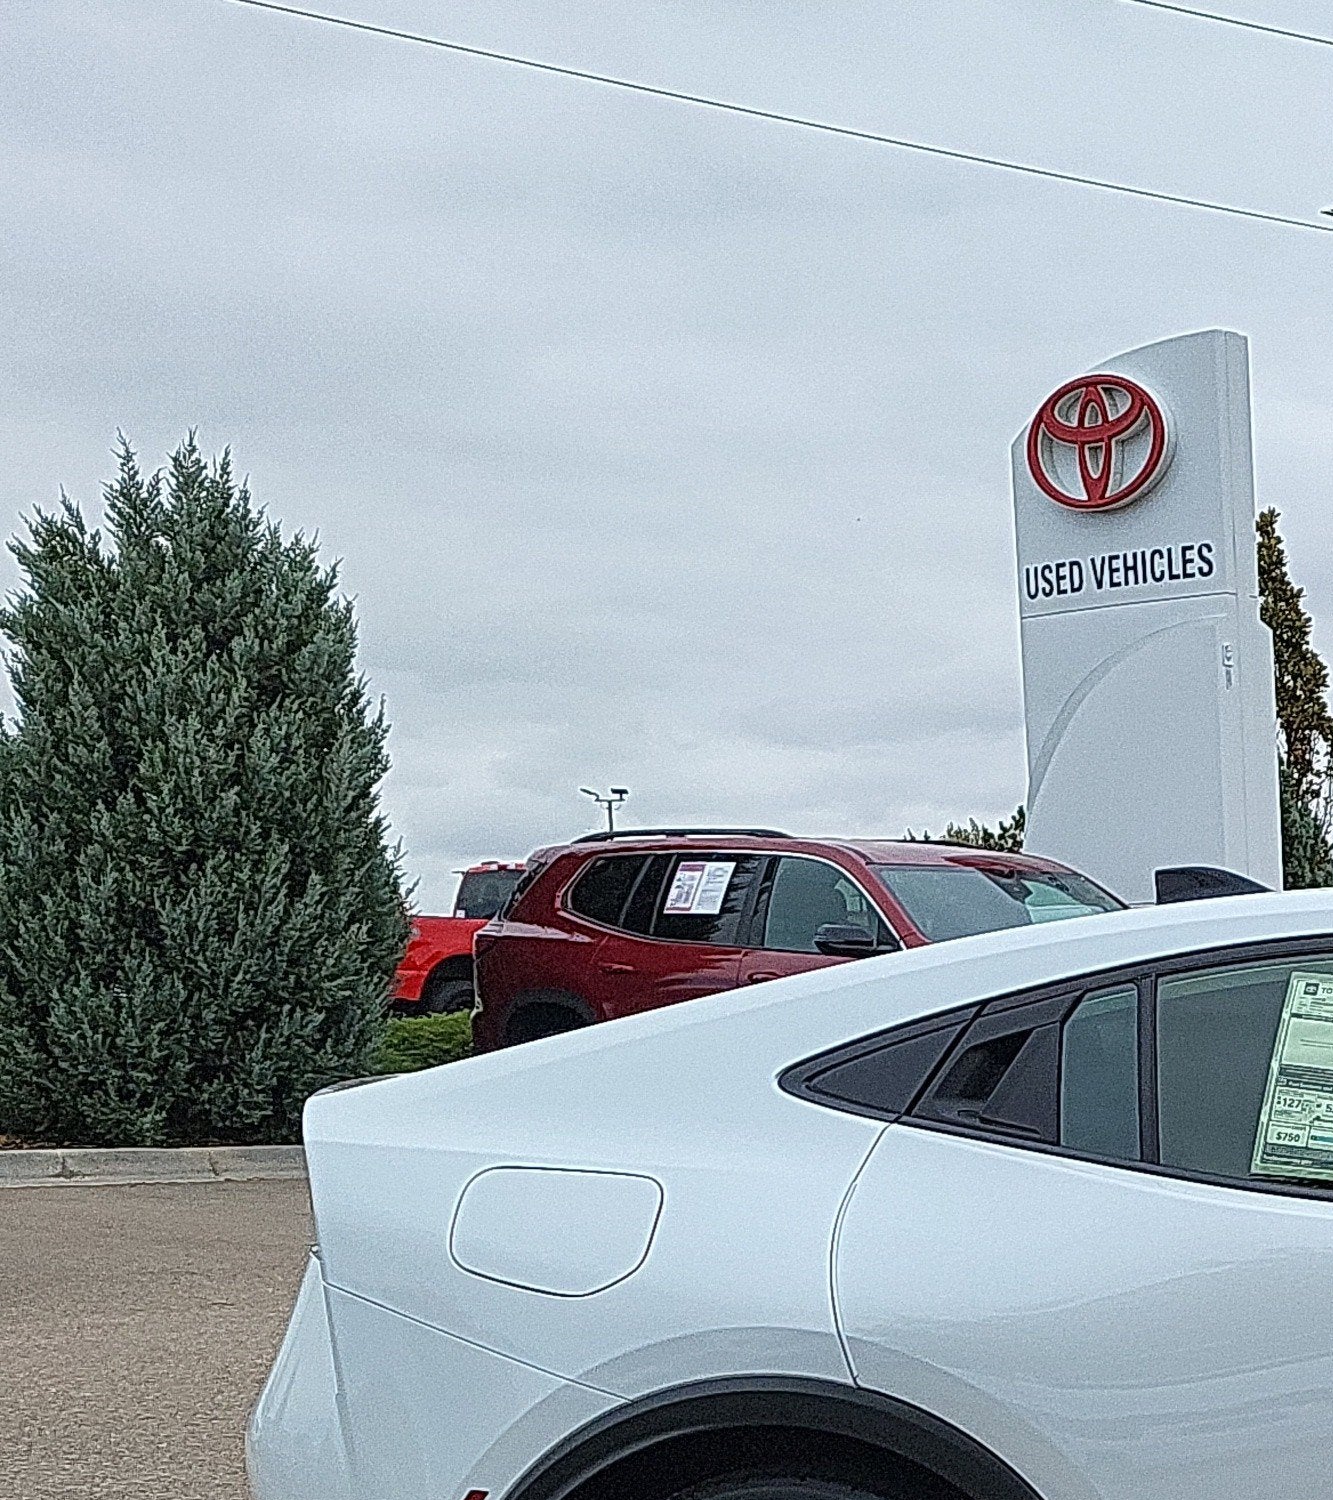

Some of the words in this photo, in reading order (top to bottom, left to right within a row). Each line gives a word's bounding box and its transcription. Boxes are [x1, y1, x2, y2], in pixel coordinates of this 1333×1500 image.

[1025, 559, 1084, 600] USED
[1089, 542, 1215, 590] VEHICLES
[1282, 1097, 1302, 1108] 127
[1275, 1131, 1301, 1142] $750
